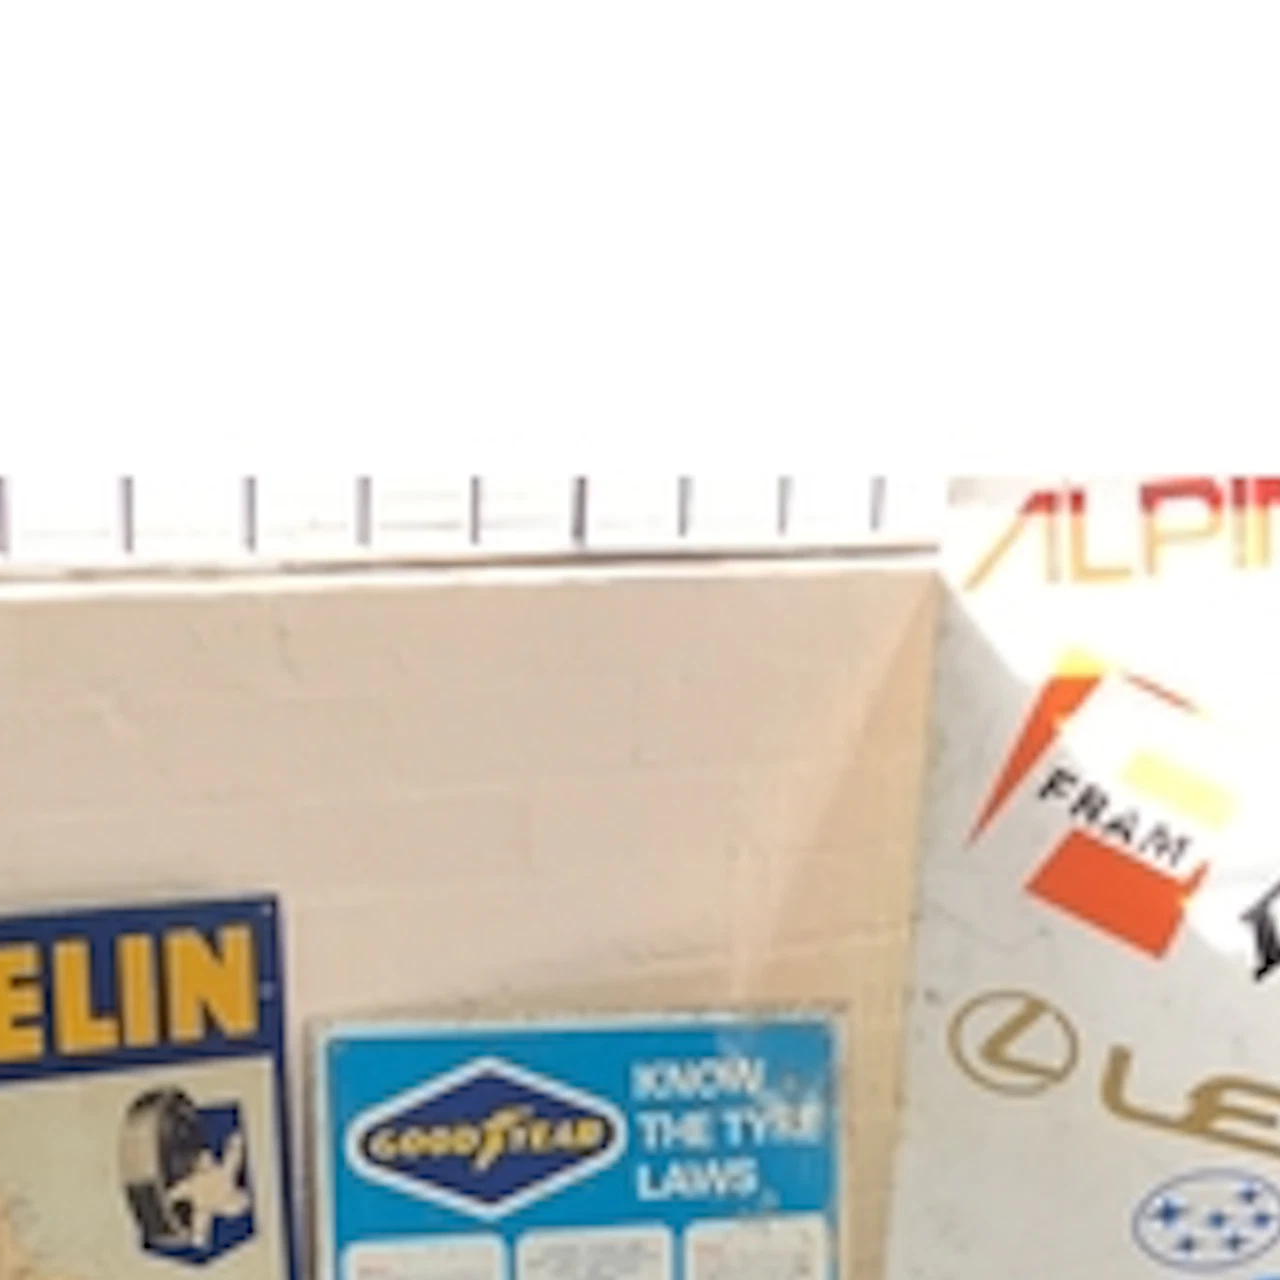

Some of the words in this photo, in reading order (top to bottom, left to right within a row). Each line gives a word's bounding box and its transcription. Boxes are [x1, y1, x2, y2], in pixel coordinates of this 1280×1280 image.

[1037, 765, 1190, 868] FRAM
[631, 1057, 766, 1099] KNOW
[637, 1108, 712, 1151] THE
[723, 1102, 820, 1148] TYRE
[636, 1160, 760, 1201] LAWS
